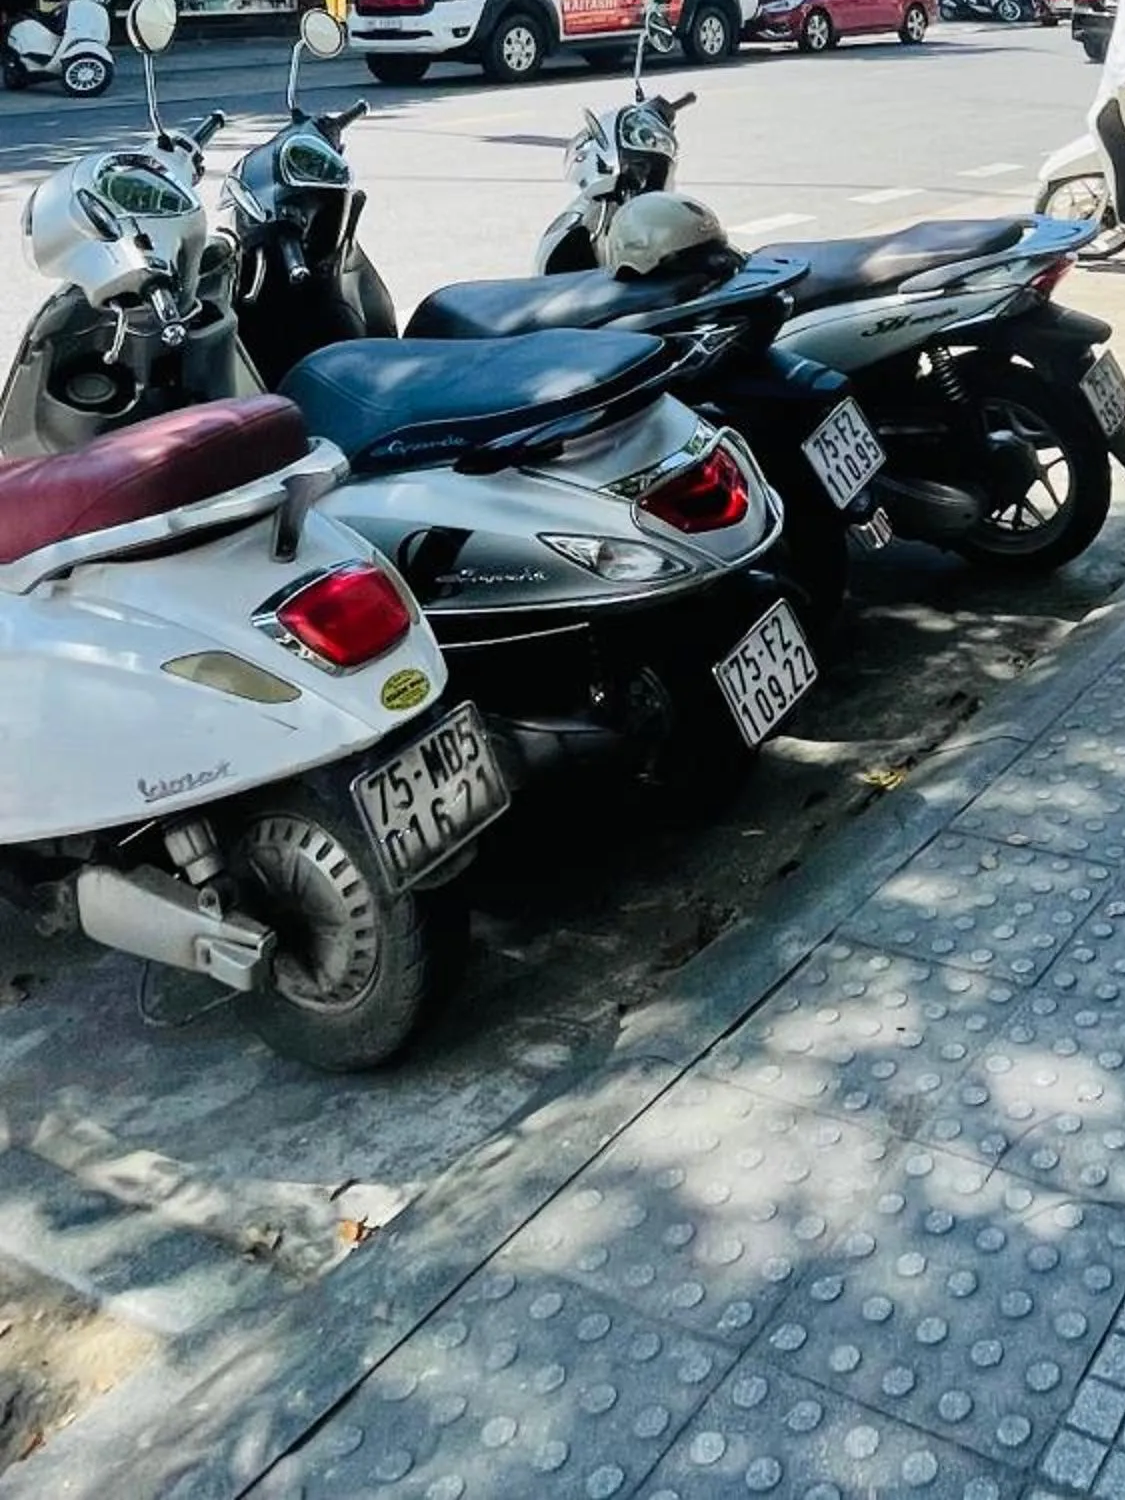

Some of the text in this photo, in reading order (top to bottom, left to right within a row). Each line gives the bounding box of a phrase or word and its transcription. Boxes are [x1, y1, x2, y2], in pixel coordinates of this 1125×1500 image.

[813, 411, 861, 469] 75-F2
[826, 432, 881, 501] 110.95
[727, 615, 793, 697] 75-F2
[740, 645, 815, 738] 109.22
